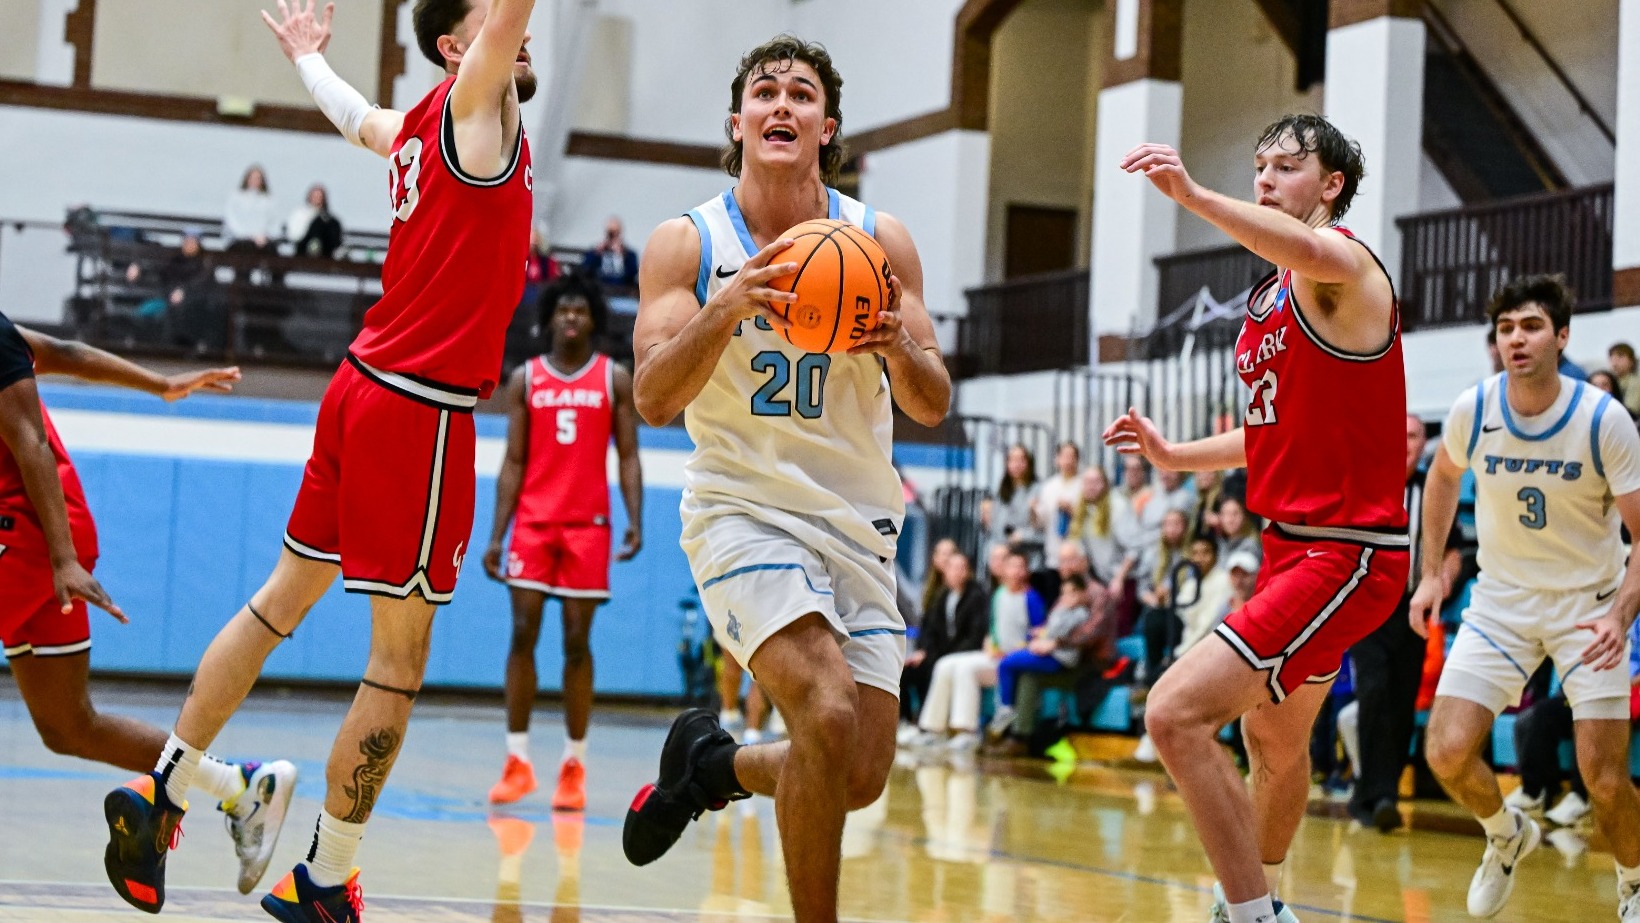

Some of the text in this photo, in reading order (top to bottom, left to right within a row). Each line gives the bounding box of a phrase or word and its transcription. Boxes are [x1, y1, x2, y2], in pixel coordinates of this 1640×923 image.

[1236, 325, 1288, 374] CLARK
[531, 387, 605, 409] CLARK
[750, 350, 832, 419] 20
[555, 408, 578, 446] 5
[1484, 454, 1583, 481] TUFTS
[1517, 486, 1547, 530] 3
